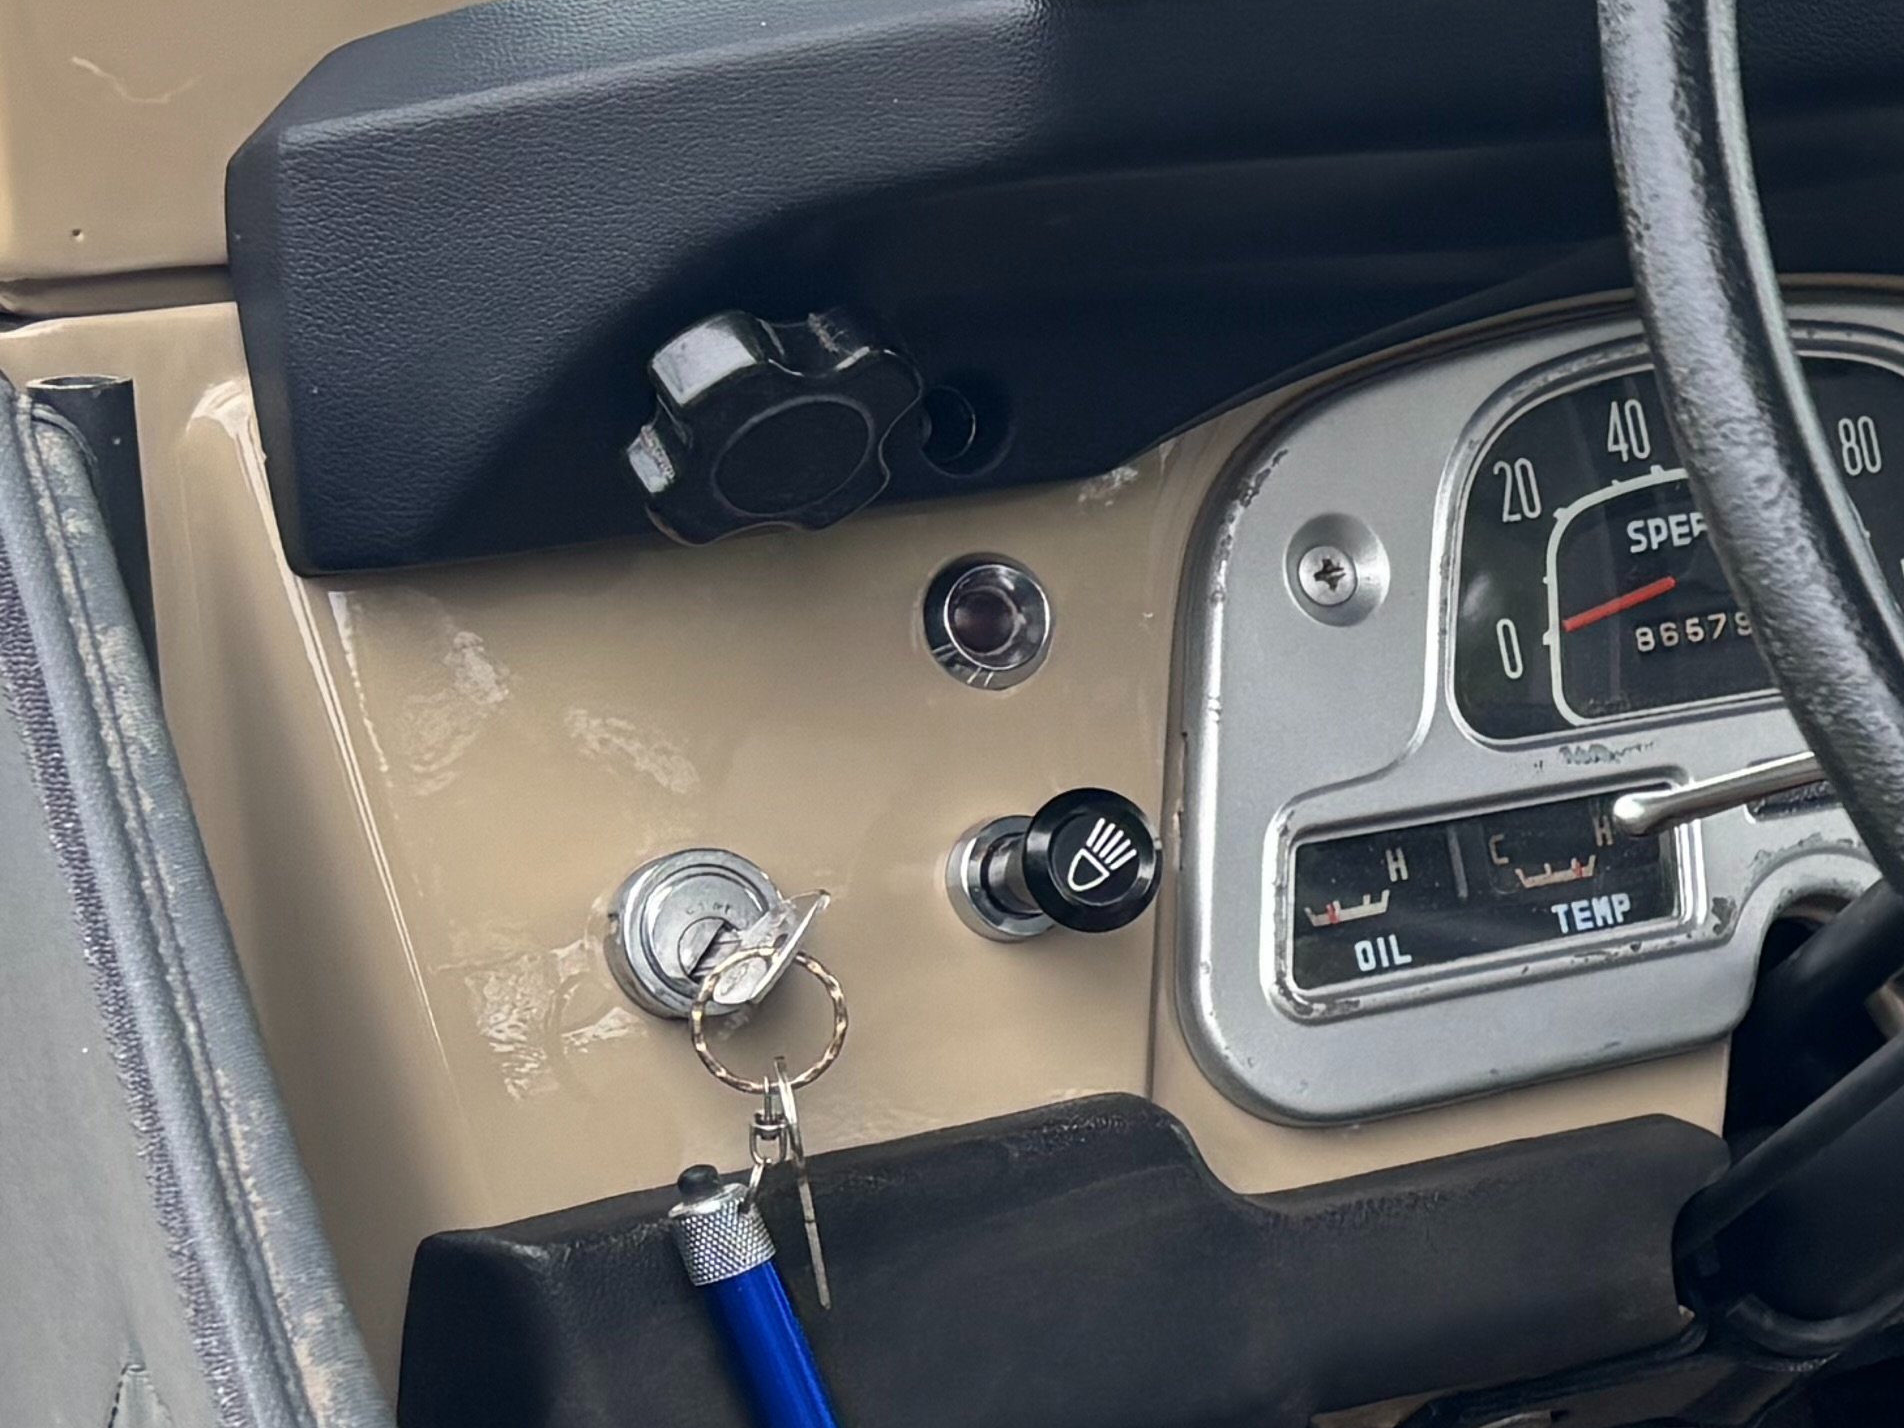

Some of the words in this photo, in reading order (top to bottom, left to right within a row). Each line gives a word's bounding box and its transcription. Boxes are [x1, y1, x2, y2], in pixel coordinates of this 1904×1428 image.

[1606, 398, 1652, 463] 40
[1837, 415, 1882, 476] 80
[1492, 457, 1542, 523] 20
[1496, 618, 1523, 679] 0
[1488, 835, 1510, 865] C
[1591, 815, 1614, 847] H
[1385, 847, 1409, 882] H
[1551, 892, 1632, 935] TEMP
[1354, 933, 1413, 972] OIL
